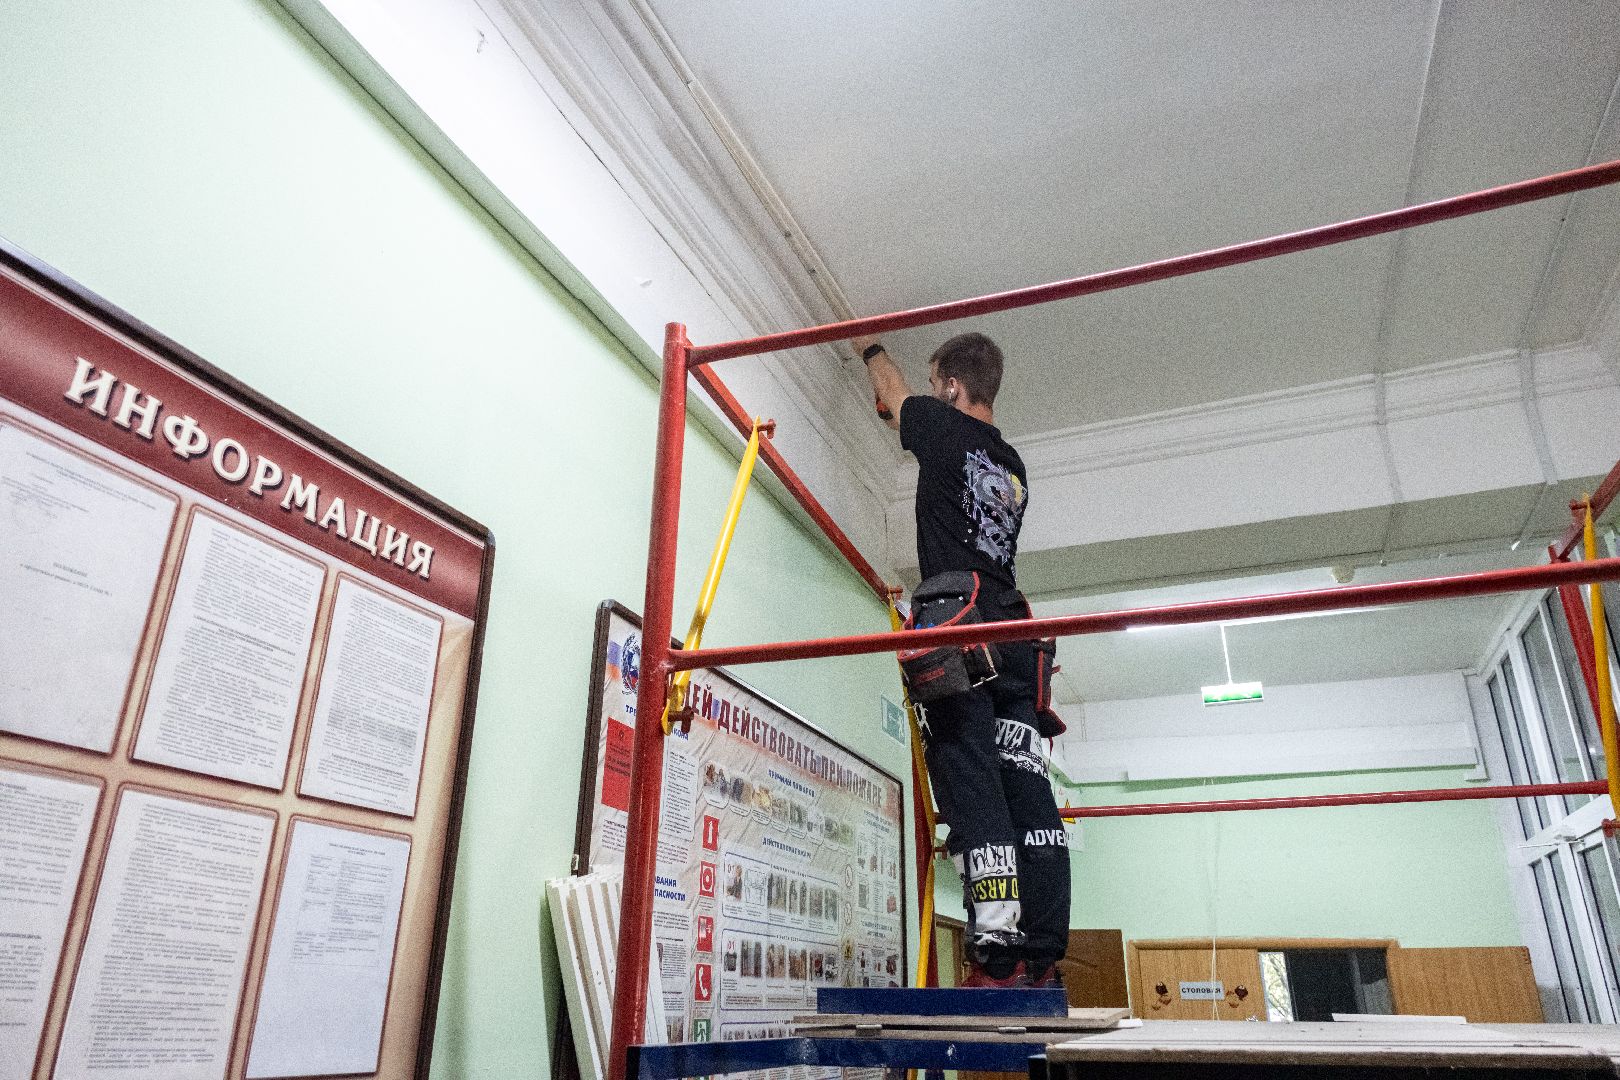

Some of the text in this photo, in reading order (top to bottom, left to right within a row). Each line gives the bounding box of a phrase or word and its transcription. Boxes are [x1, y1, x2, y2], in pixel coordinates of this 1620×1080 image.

[64, 356, 435, 579] ИНФОРМАЦИЯ
[717, 698, 817, 775] ДЕЙСТВОВАТЬ
[820, 755, 843, 788] ПРИ
[846, 769, 882, 808] ПОЖАРЕ
[654, 888, 686, 902] ПАСНОСТИ
[655, 875, 677, 888] ВАНИЯ
